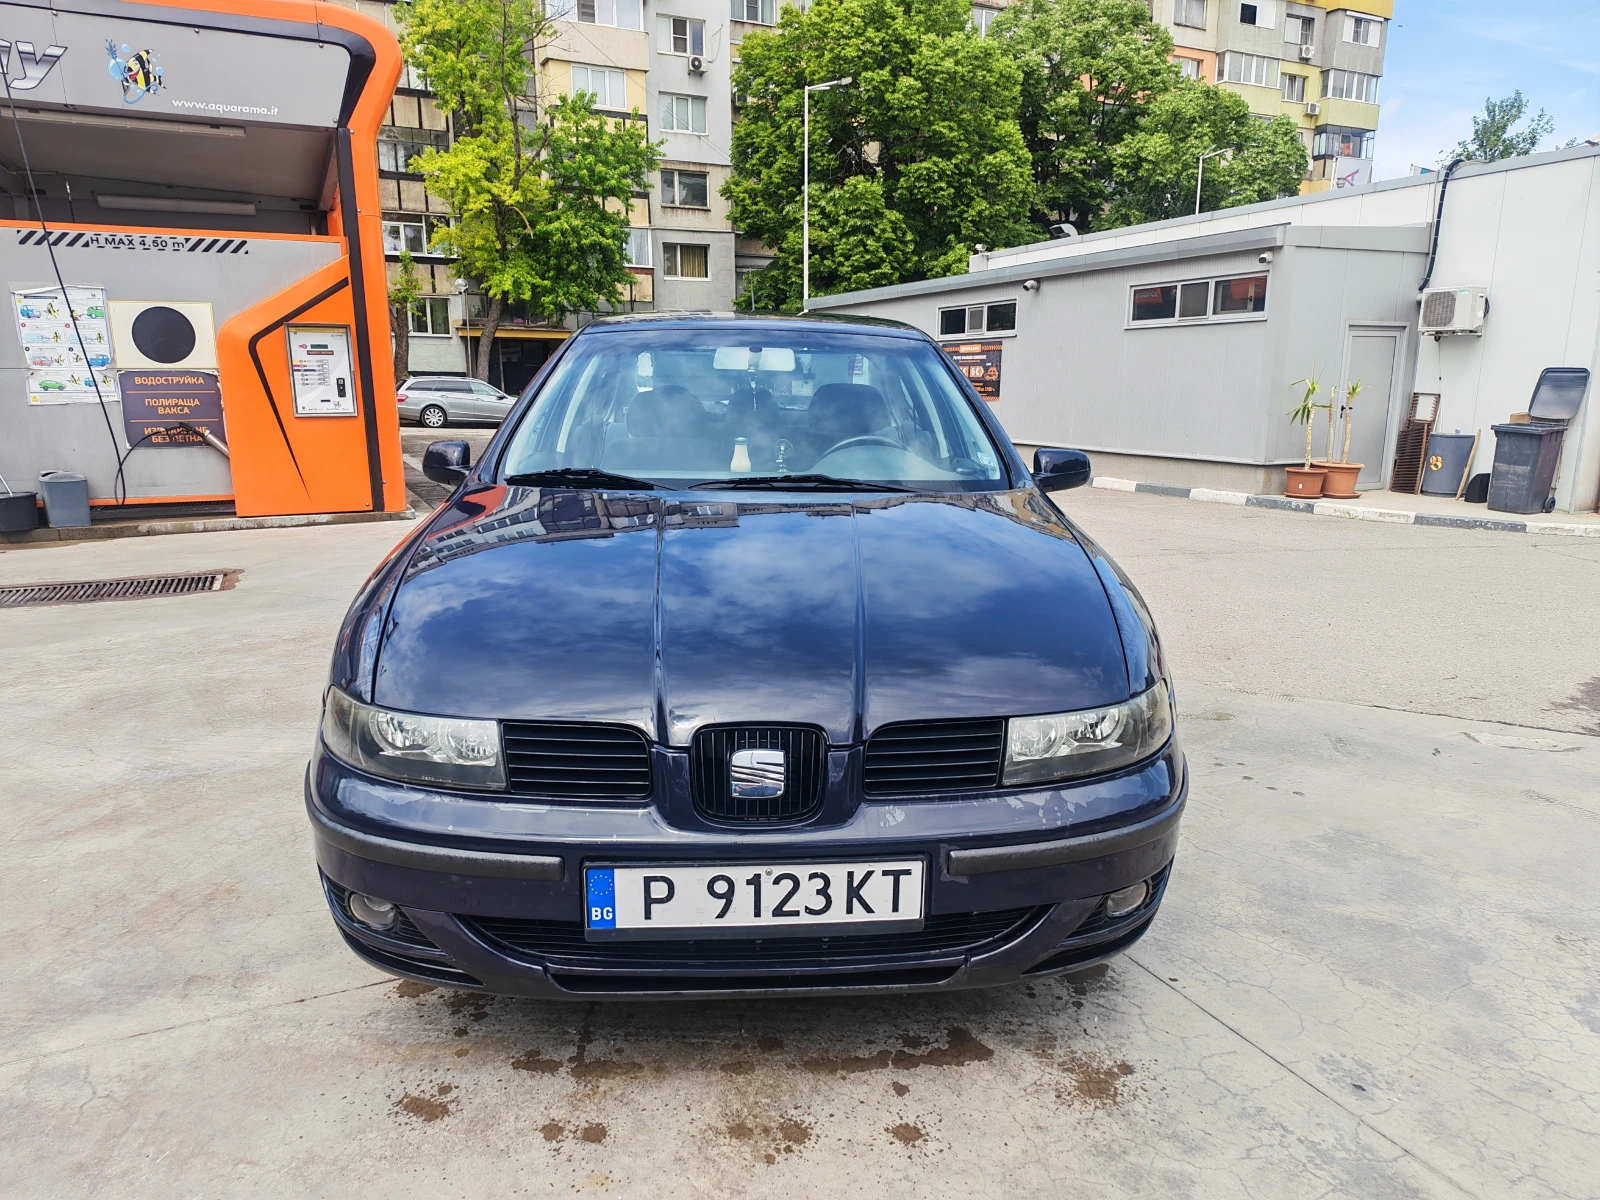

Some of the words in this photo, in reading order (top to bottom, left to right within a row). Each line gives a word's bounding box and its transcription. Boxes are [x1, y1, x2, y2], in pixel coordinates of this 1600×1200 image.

[171, 99, 279, 115] www.aquarama.it
[90, 236, 100, 245] H
[105, 237, 135, 247] MAX
[139, 239, 168, 248] 4.50
[172, 241, 185, 249] m
[134, 375, 205, 386] ВОДОСТРУЙКА
[145, 398, 201, 407] ПОЛИРАЩА
[157, 406, 190, 415] ВАКСА
[151, 435, 170, 443] БЕЗ
[706, 868, 912, 919] 9123KT
[591, 906, 613, 921] BG
